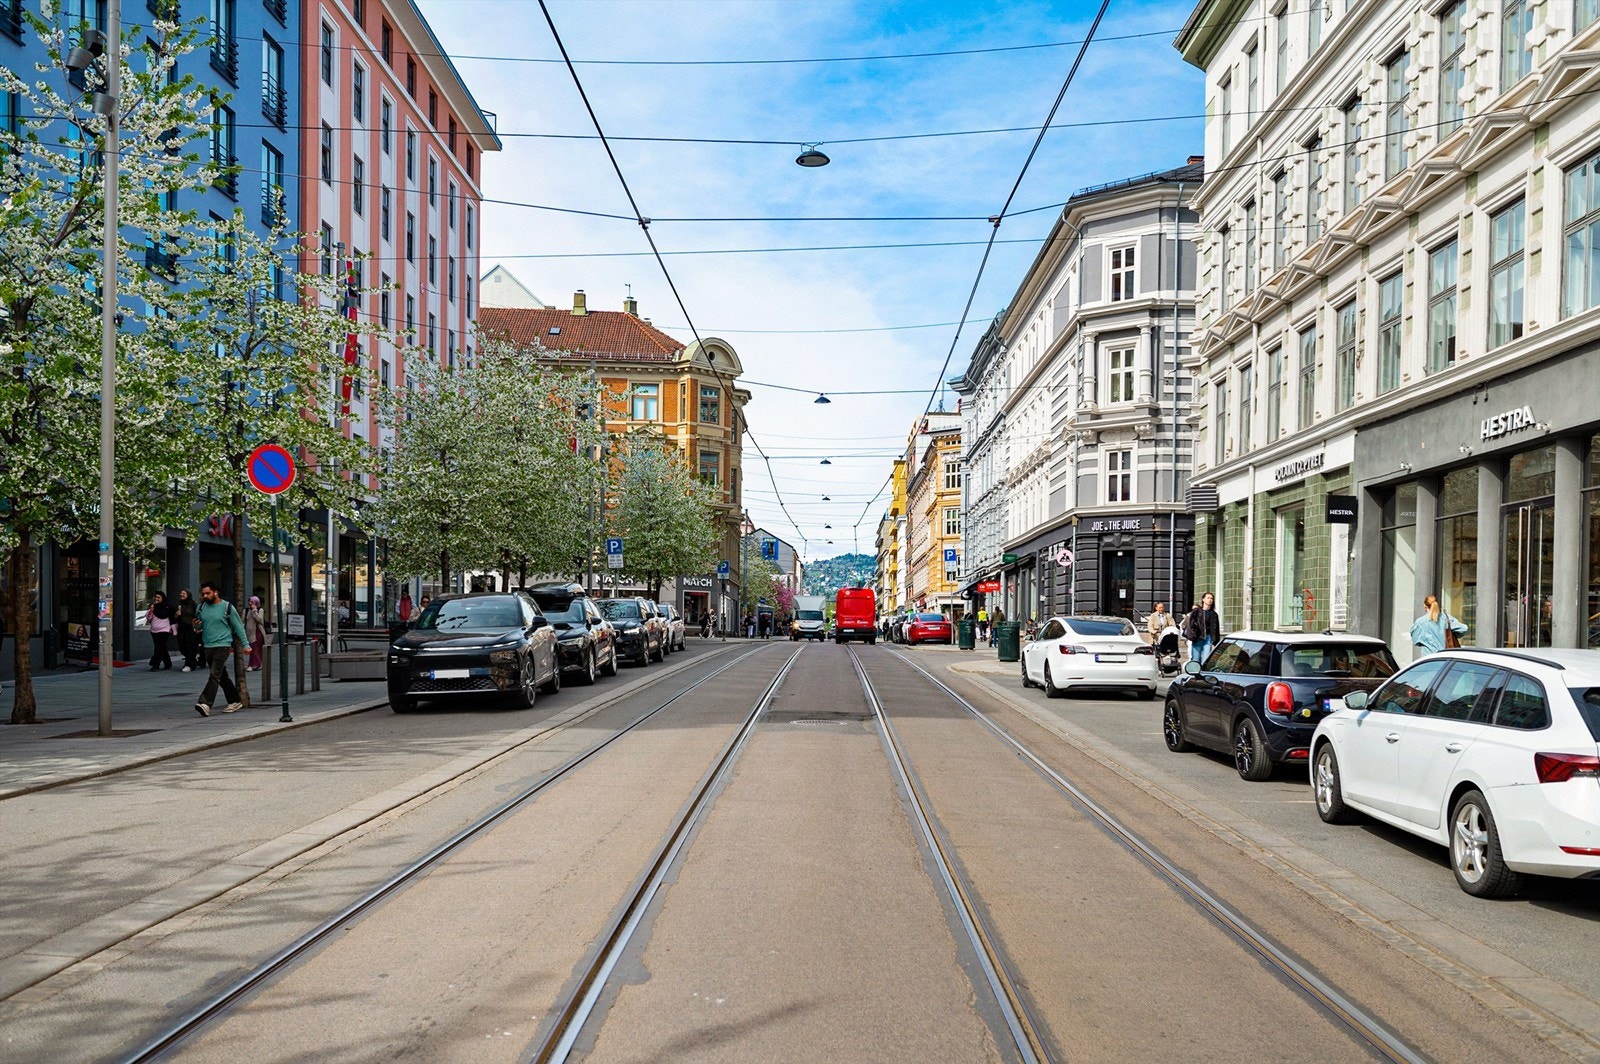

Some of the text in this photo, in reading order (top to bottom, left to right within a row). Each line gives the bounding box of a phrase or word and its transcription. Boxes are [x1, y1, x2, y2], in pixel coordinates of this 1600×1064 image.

[1480, 405, 1536, 440] HESTRA
[1091, 521, 1104, 531] JOE
[1108, 520, 1121, 531] THE
[1121, 519, 1141, 530] JUICE
[610, 541, 619, 553] P
[946, 550, 954, 560] P
[683, 577, 713, 587] MATCH
